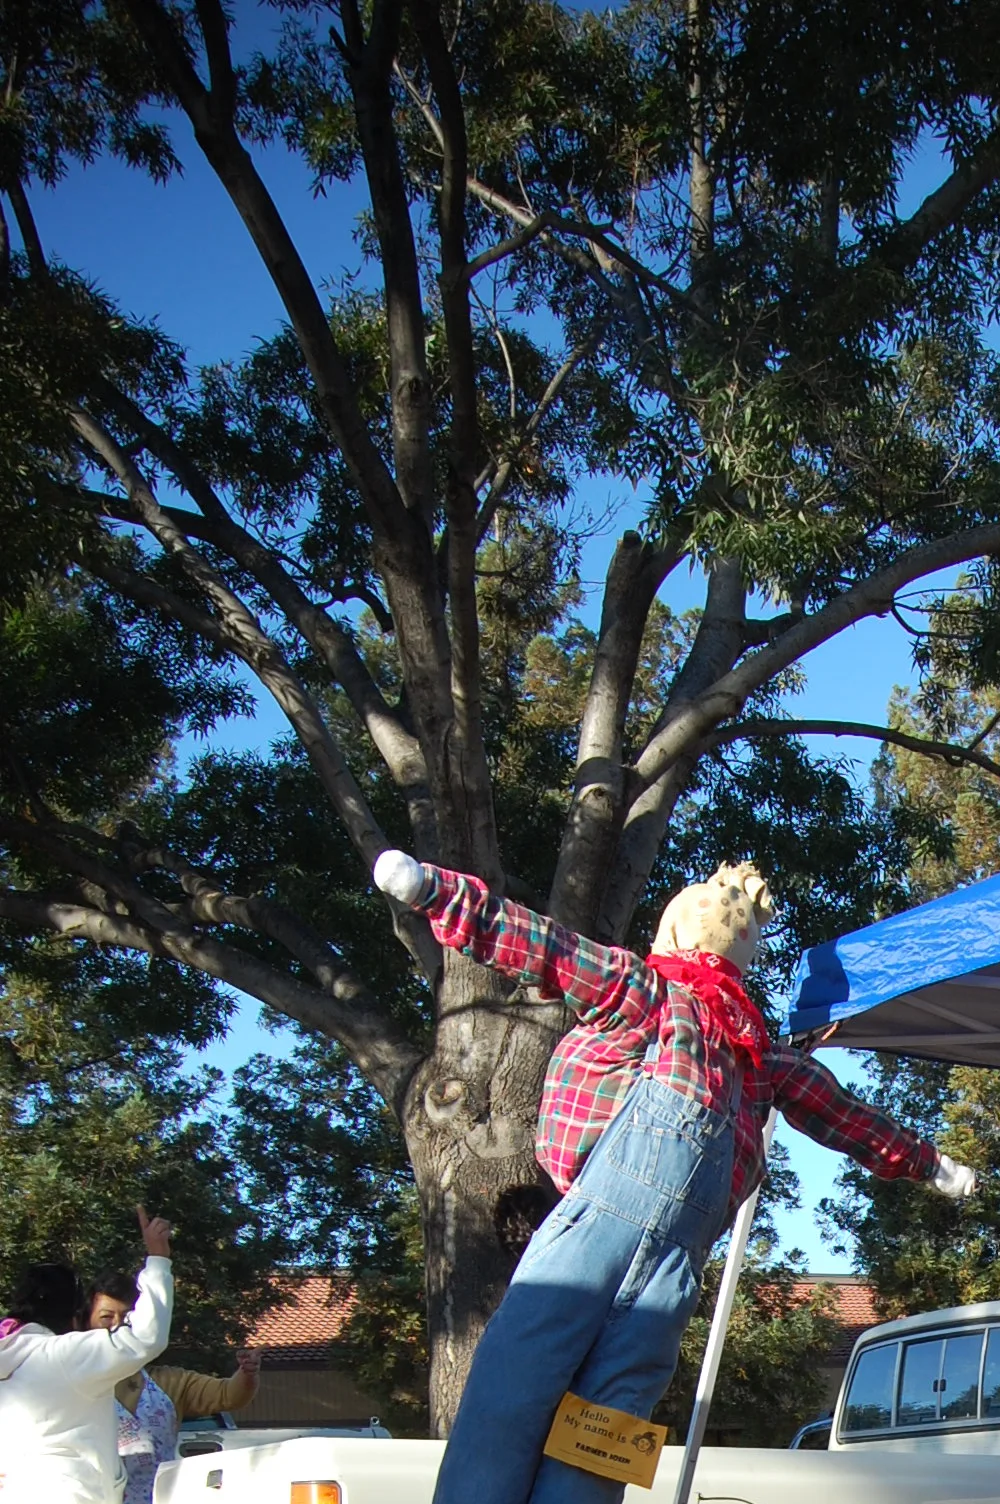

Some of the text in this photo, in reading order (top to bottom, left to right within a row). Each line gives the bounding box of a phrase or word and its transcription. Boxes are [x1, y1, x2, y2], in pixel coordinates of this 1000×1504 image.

[579, 1408, 610, 1424] Hello
[564, 1414, 627, 1444] My name is
